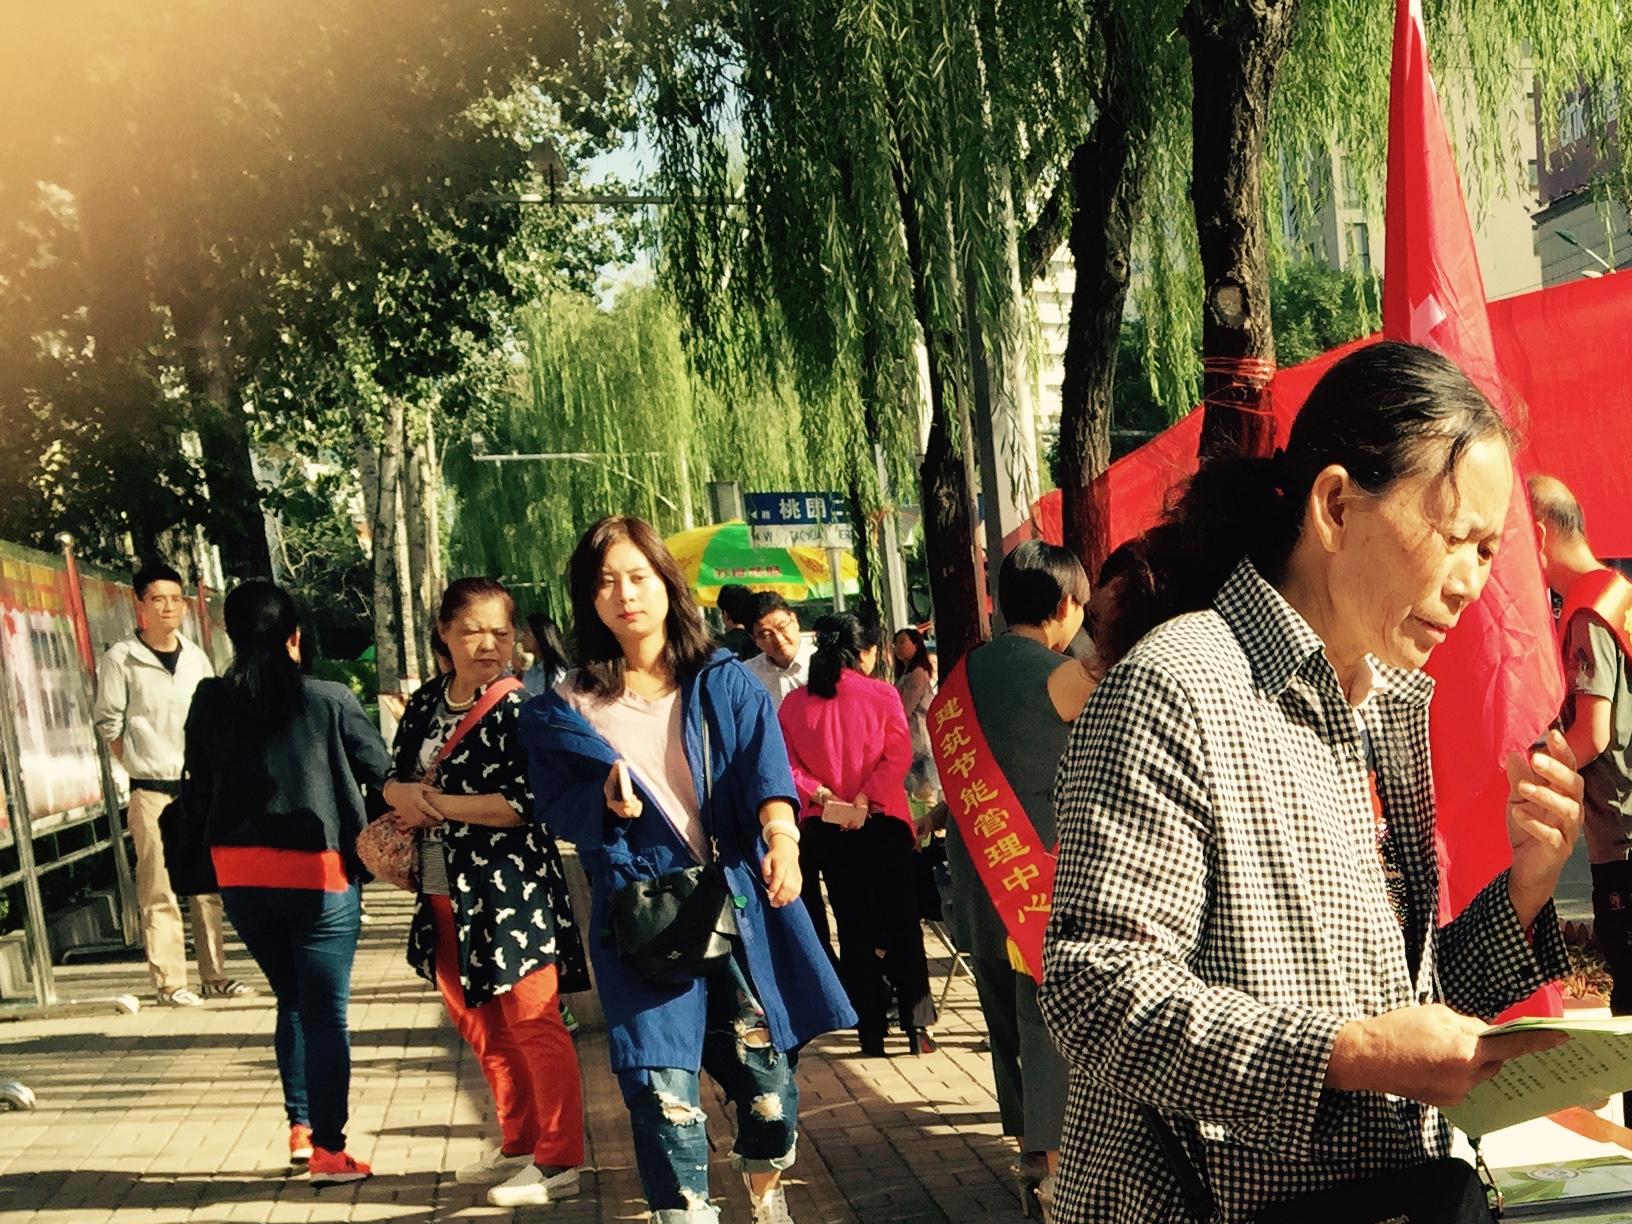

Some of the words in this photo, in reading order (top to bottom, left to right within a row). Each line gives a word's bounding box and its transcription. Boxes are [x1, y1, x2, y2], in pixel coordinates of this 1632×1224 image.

[935, 697, 1052, 923] 建筑节能管理中心
